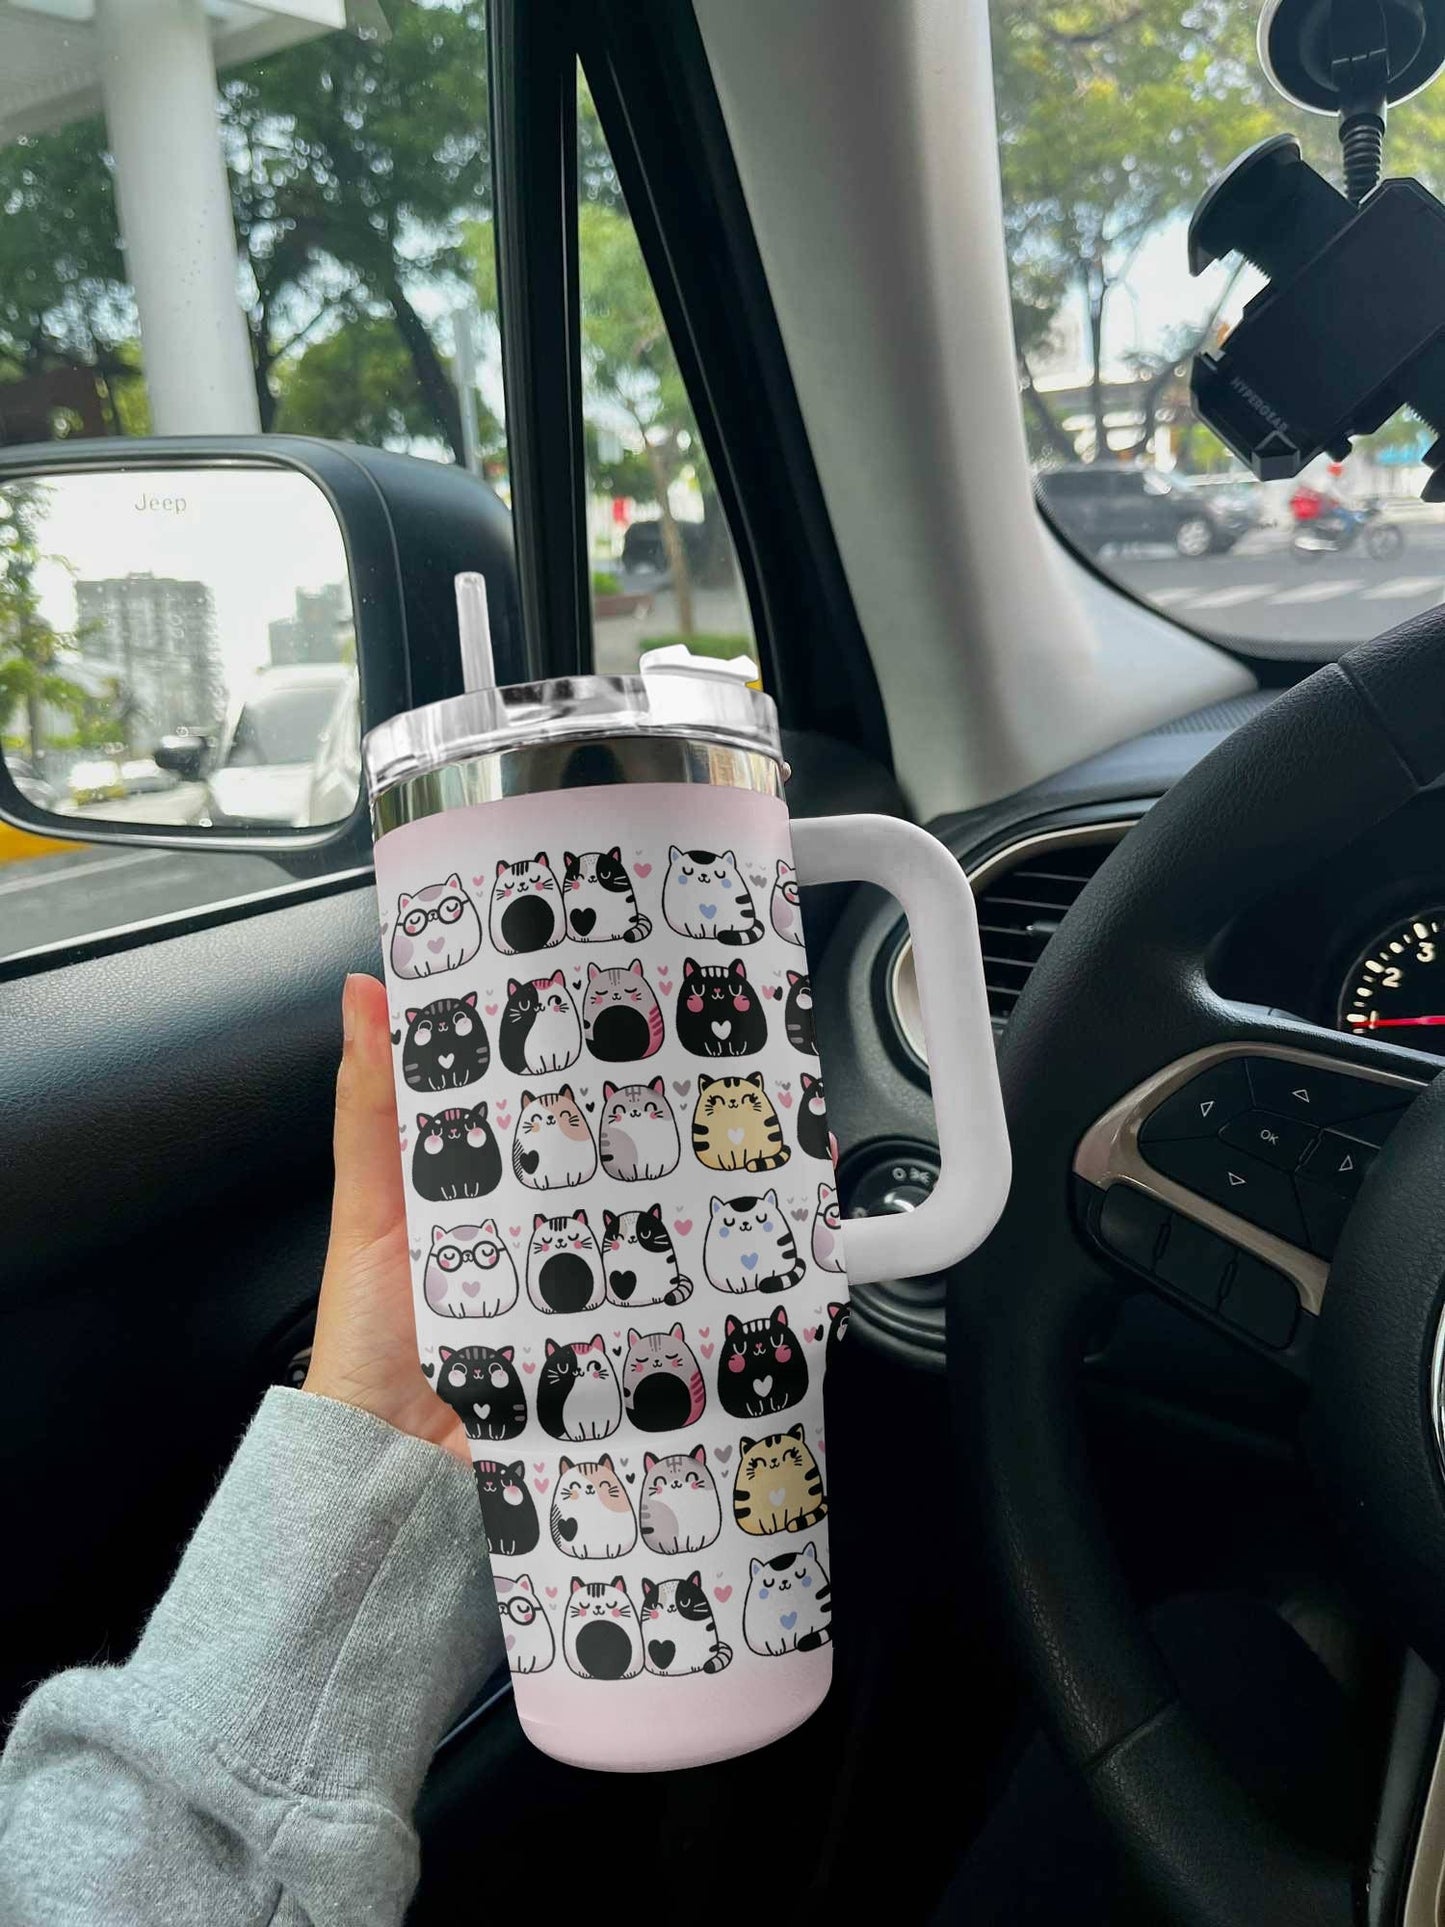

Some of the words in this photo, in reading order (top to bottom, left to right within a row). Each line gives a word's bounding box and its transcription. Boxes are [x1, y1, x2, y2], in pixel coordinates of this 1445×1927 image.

[134, 492, 187, 515] Jeep
[1416, 942, 1435, 962] 3
[1382, 967, 1402, 988] 2
[1260, 1129, 1279, 1145] OK
